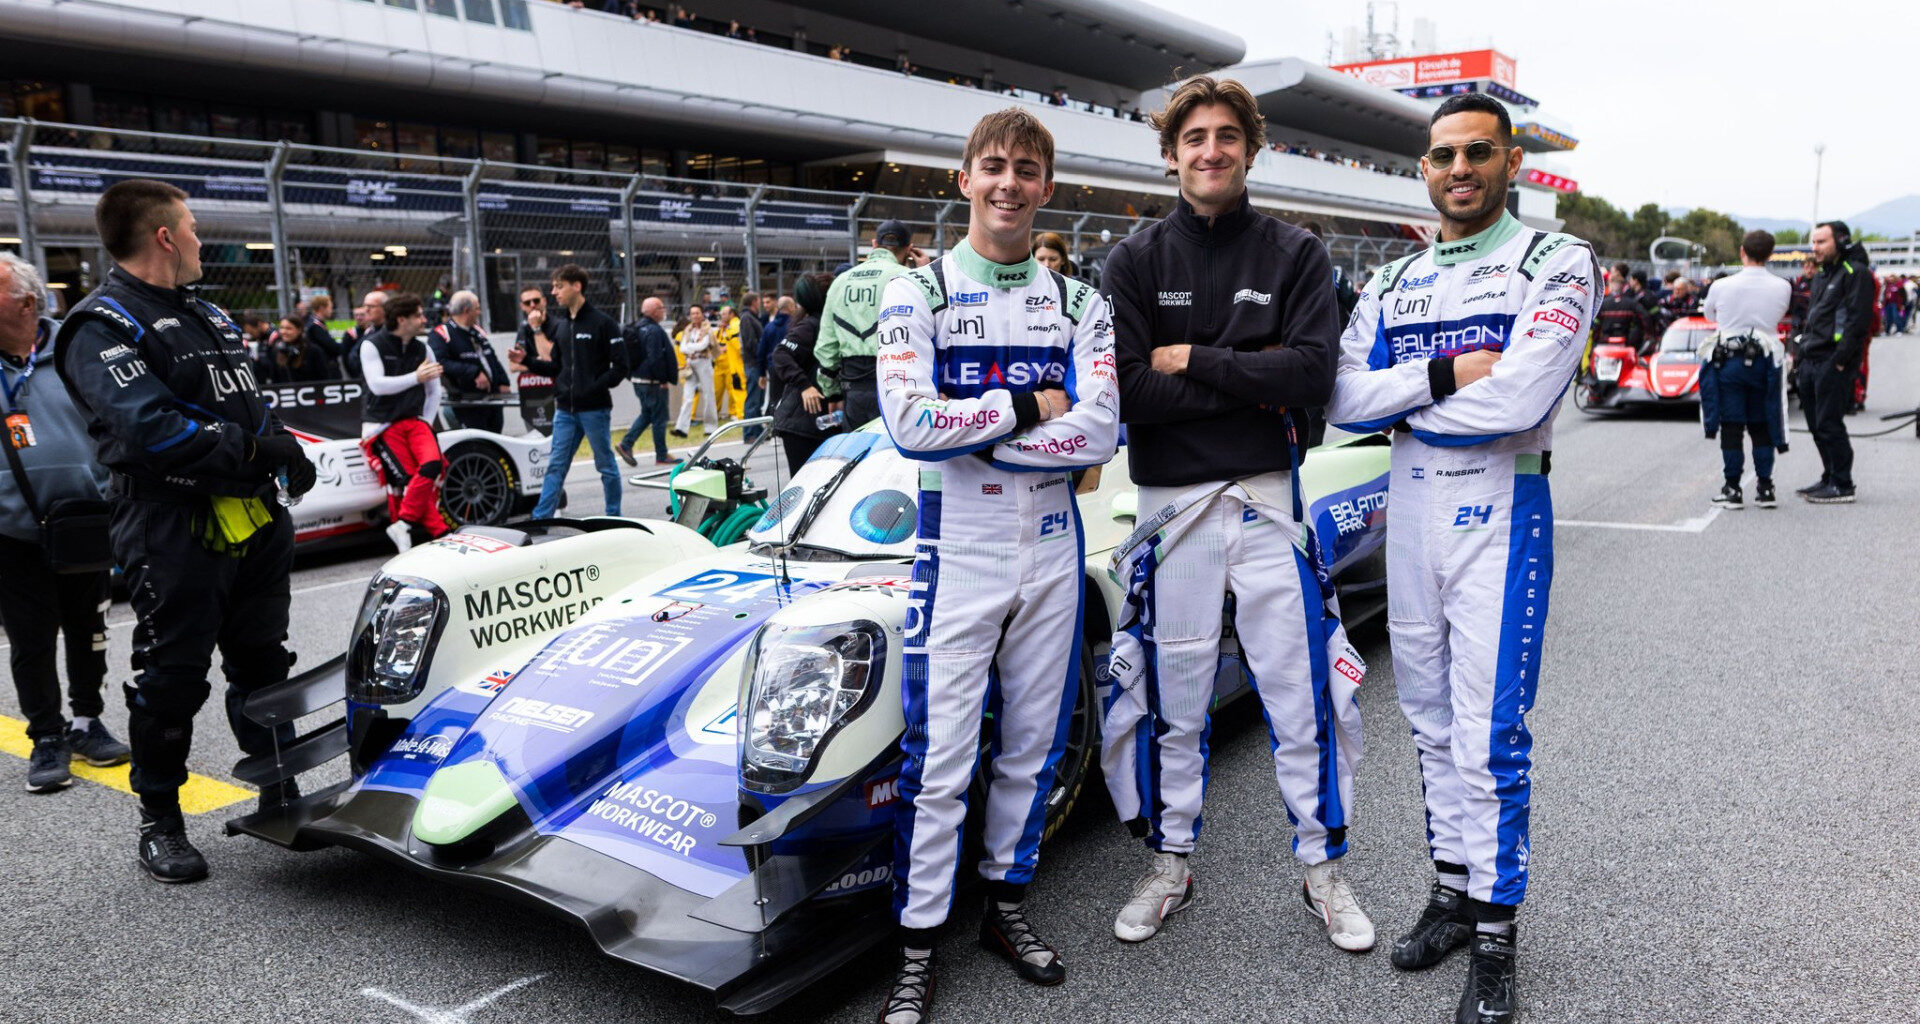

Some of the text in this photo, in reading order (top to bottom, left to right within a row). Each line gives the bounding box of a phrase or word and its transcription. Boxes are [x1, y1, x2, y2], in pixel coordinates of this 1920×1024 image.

[1440, 241, 1479, 256] HRX
[1532, 237, 1568, 265] HRX
[997, 271, 1028, 281] HRX
[845, 285, 878, 306] [un]
[1072, 284, 1090, 310] HRX
[1393, 295, 1432, 320] [un]
[949, 315, 985, 339] un]
[207, 362, 260, 401] [un]
[520, 376, 553, 387] MOTUL
[1040, 511, 1068, 536] 24
[1337, 513, 1367, 536] PARK
[1453, 505, 1493, 526] 24
[662, 573, 776, 603] 24
[497, 697, 595, 728] NIELSEN
[587, 799, 697, 857] WORKWEAR
